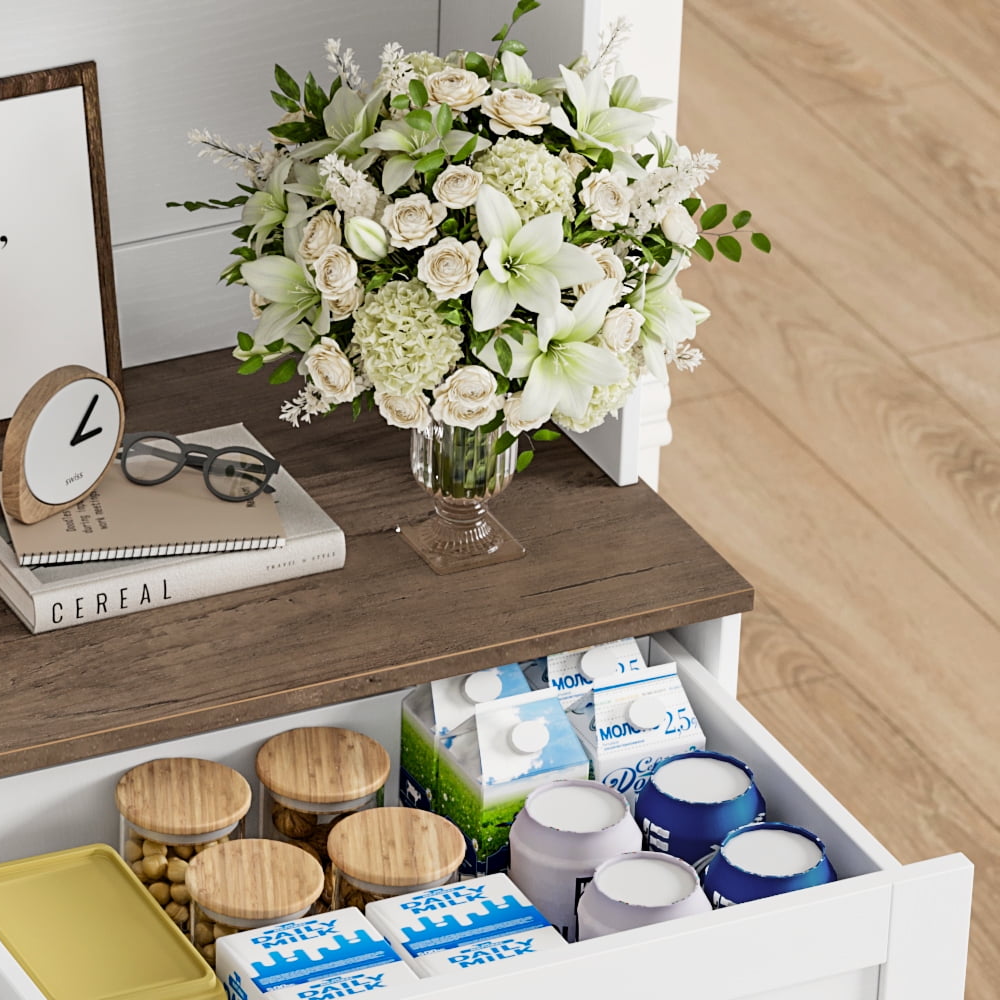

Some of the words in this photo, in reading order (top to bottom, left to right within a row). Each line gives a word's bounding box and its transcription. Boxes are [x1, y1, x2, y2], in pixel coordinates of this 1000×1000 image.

[51, 578, 172, 625] CEREAL
[400, 885, 486, 910] DAILY
[412, 893, 488, 915] MILK
[250, 919, 338, 945] DAILY
[262, 929, 339, 949] MILK
[447, 938, 535, 964] DAILY
[459, 947, 536, 968] MILK
[297, 973, 384, 999] DAILY
